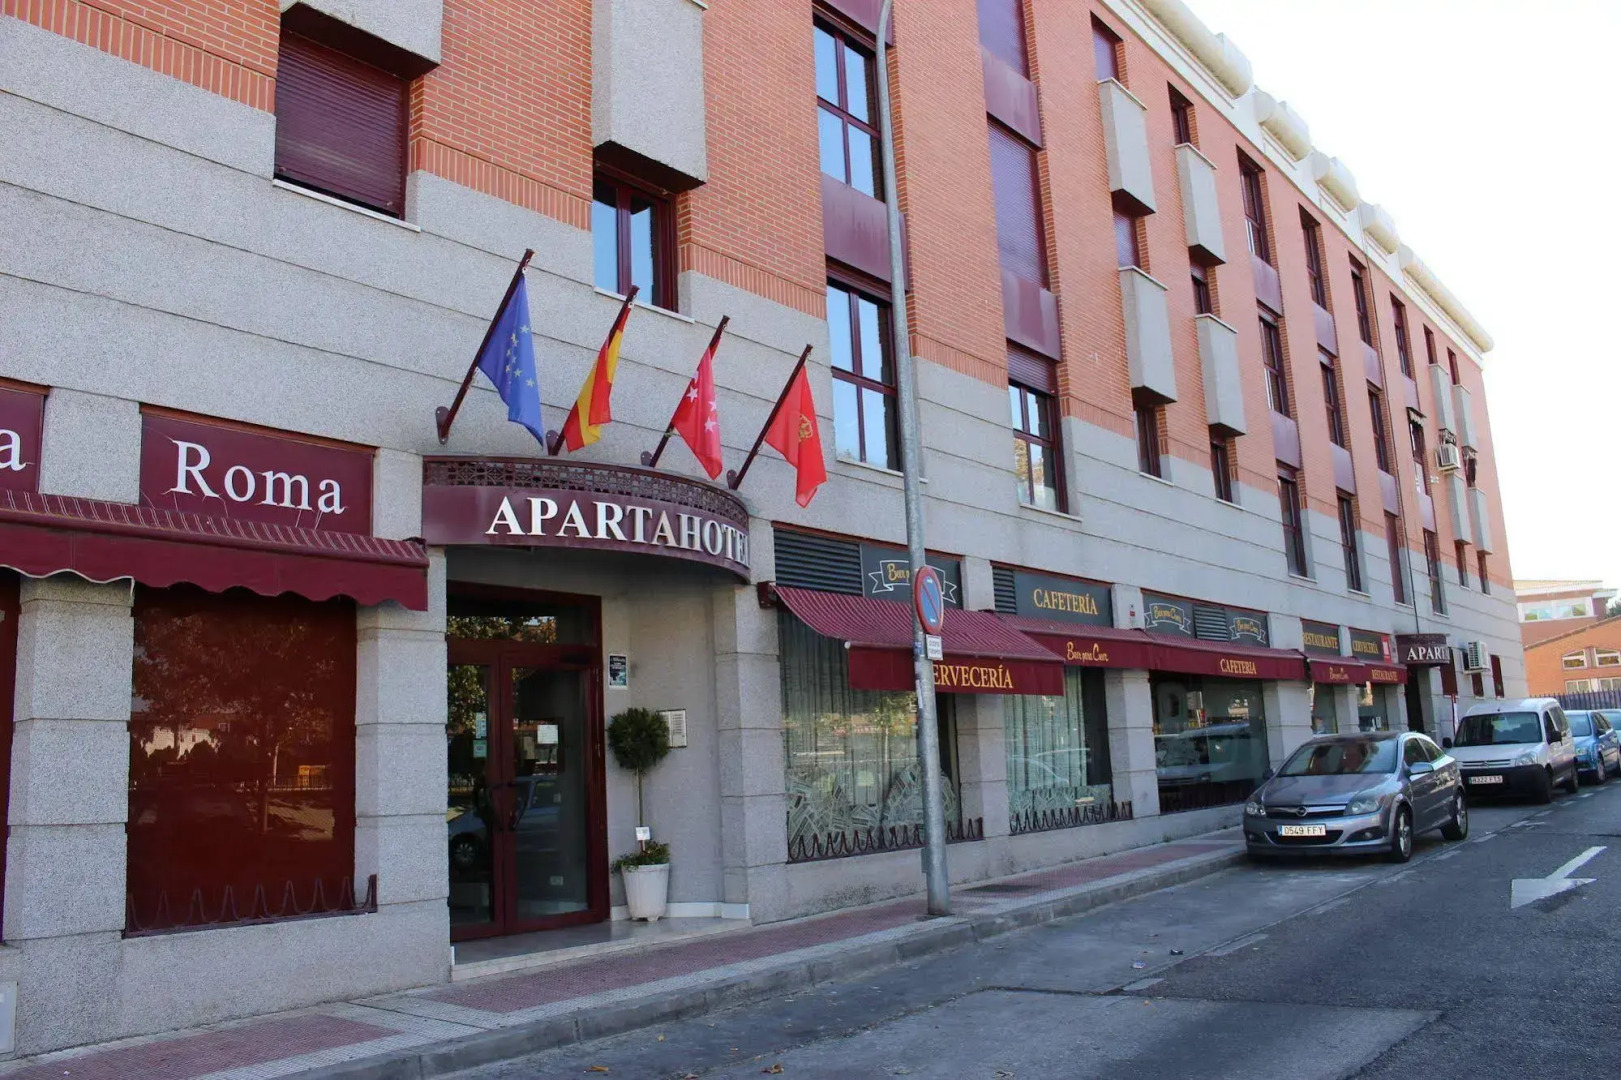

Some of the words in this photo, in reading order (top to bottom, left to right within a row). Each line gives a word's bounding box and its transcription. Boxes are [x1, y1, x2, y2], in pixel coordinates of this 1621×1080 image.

[171, 440, 345, 515] Roma
[1033, 588, 1098, 615] CAFETERÍA
[932, 664, 1014, 688] ERVECERÍA
